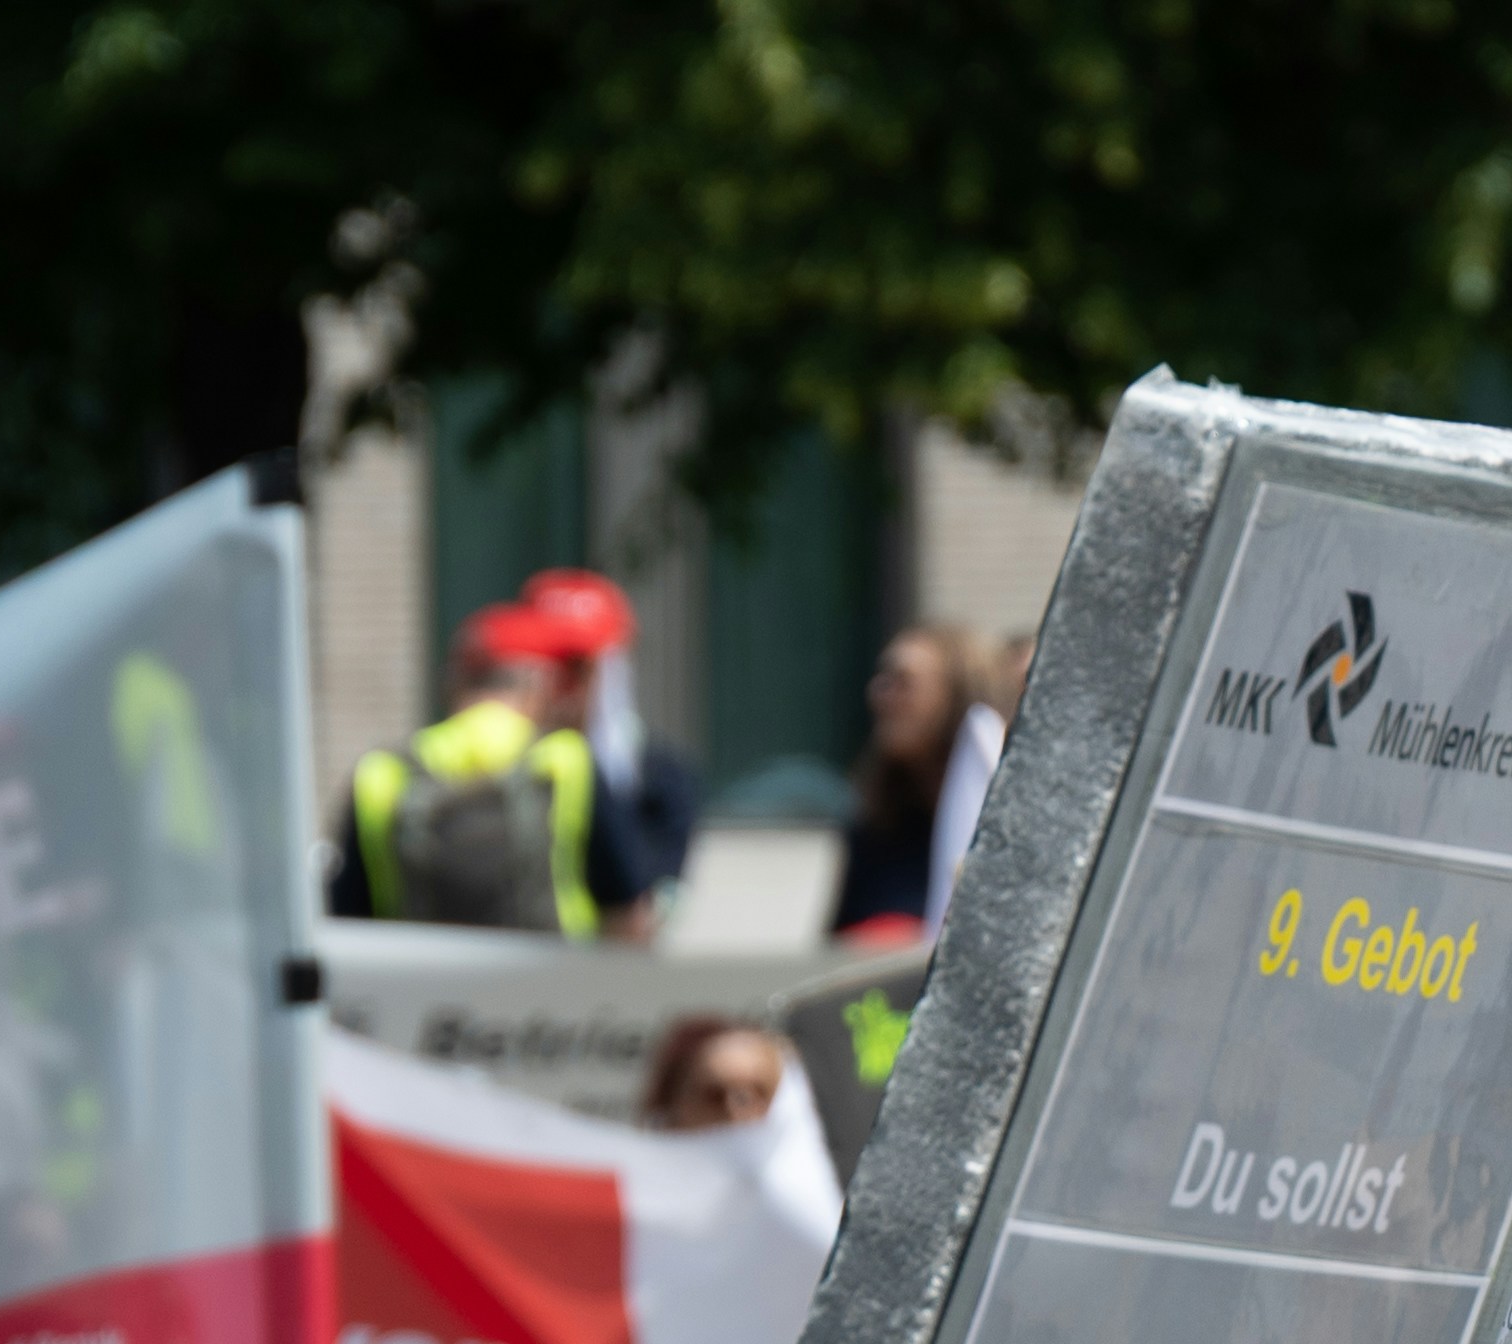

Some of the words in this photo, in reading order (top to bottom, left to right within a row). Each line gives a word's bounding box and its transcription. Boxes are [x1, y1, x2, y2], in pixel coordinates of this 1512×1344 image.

[1260, 889, 1304, 979] 9.
[1320, 896, 1479, 1004] Gebot
[1171, 1121, 1254, 1214] Du
[1256, 1143, 1406, 1234] sollst
